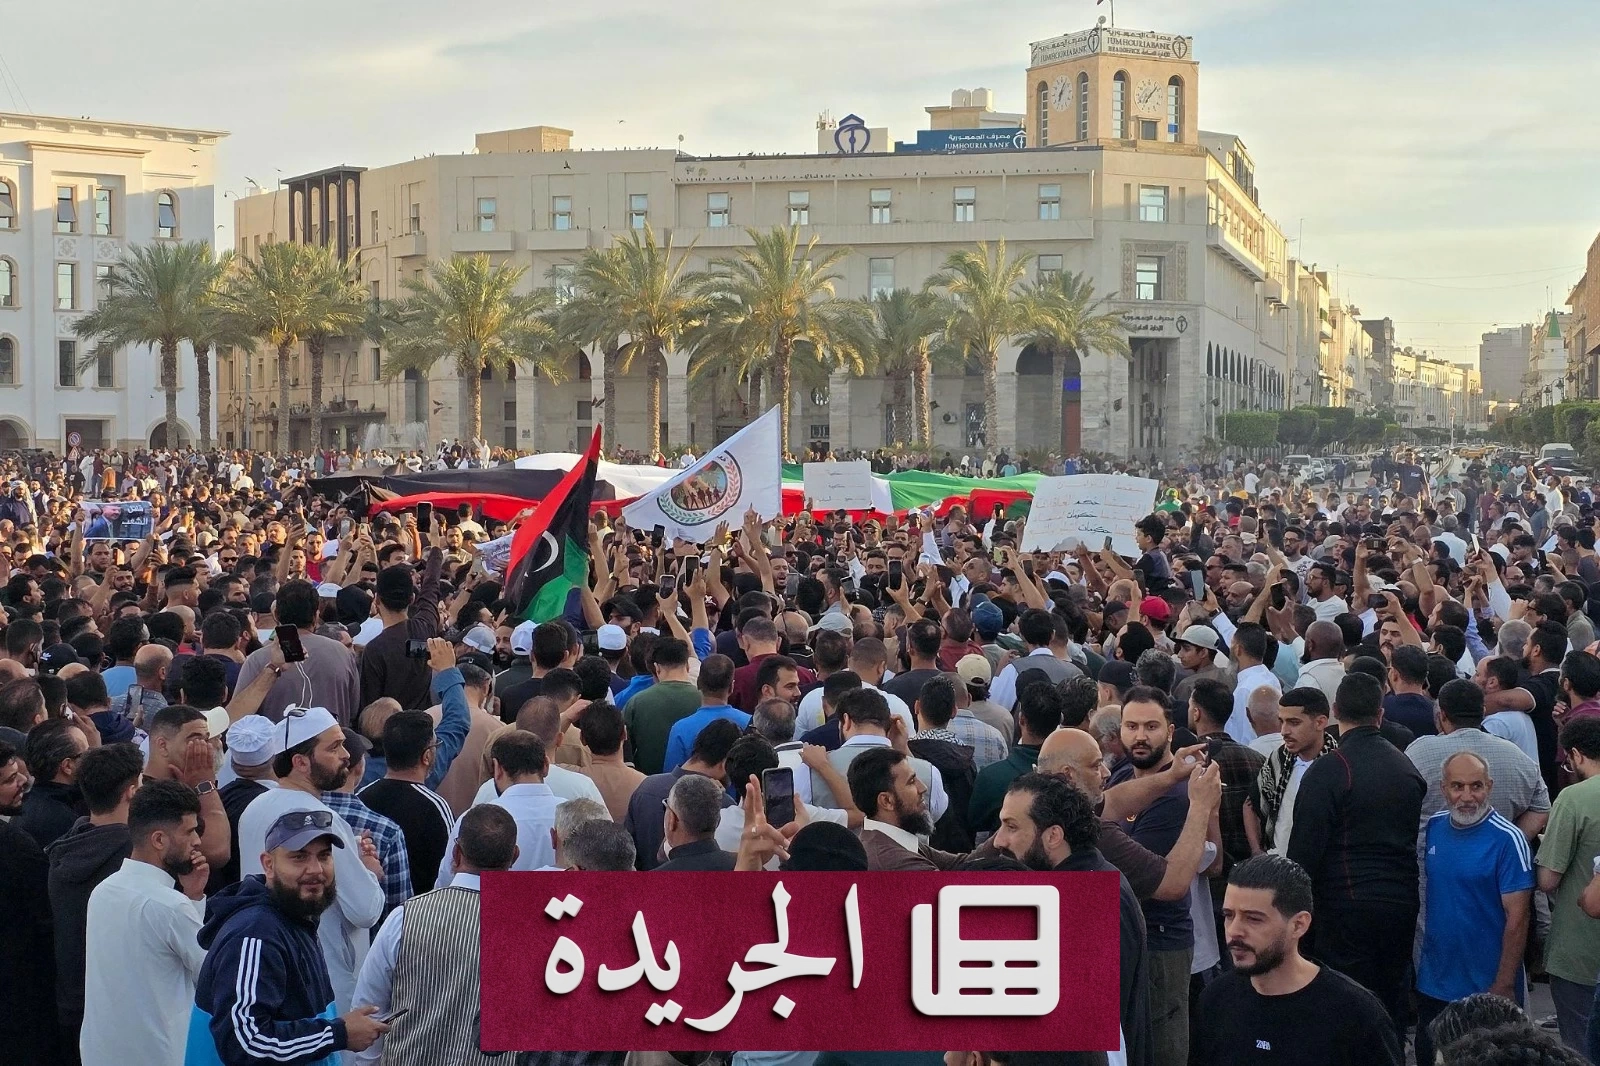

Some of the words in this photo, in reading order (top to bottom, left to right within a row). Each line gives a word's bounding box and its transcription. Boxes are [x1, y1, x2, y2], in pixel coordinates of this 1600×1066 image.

[1151, 42, 1172, 50] BANK
[986, 133, 1011, 141] مصرف
[989, 141, 1010, 149] BANK
[121, 516, 148, 528] الشعب
